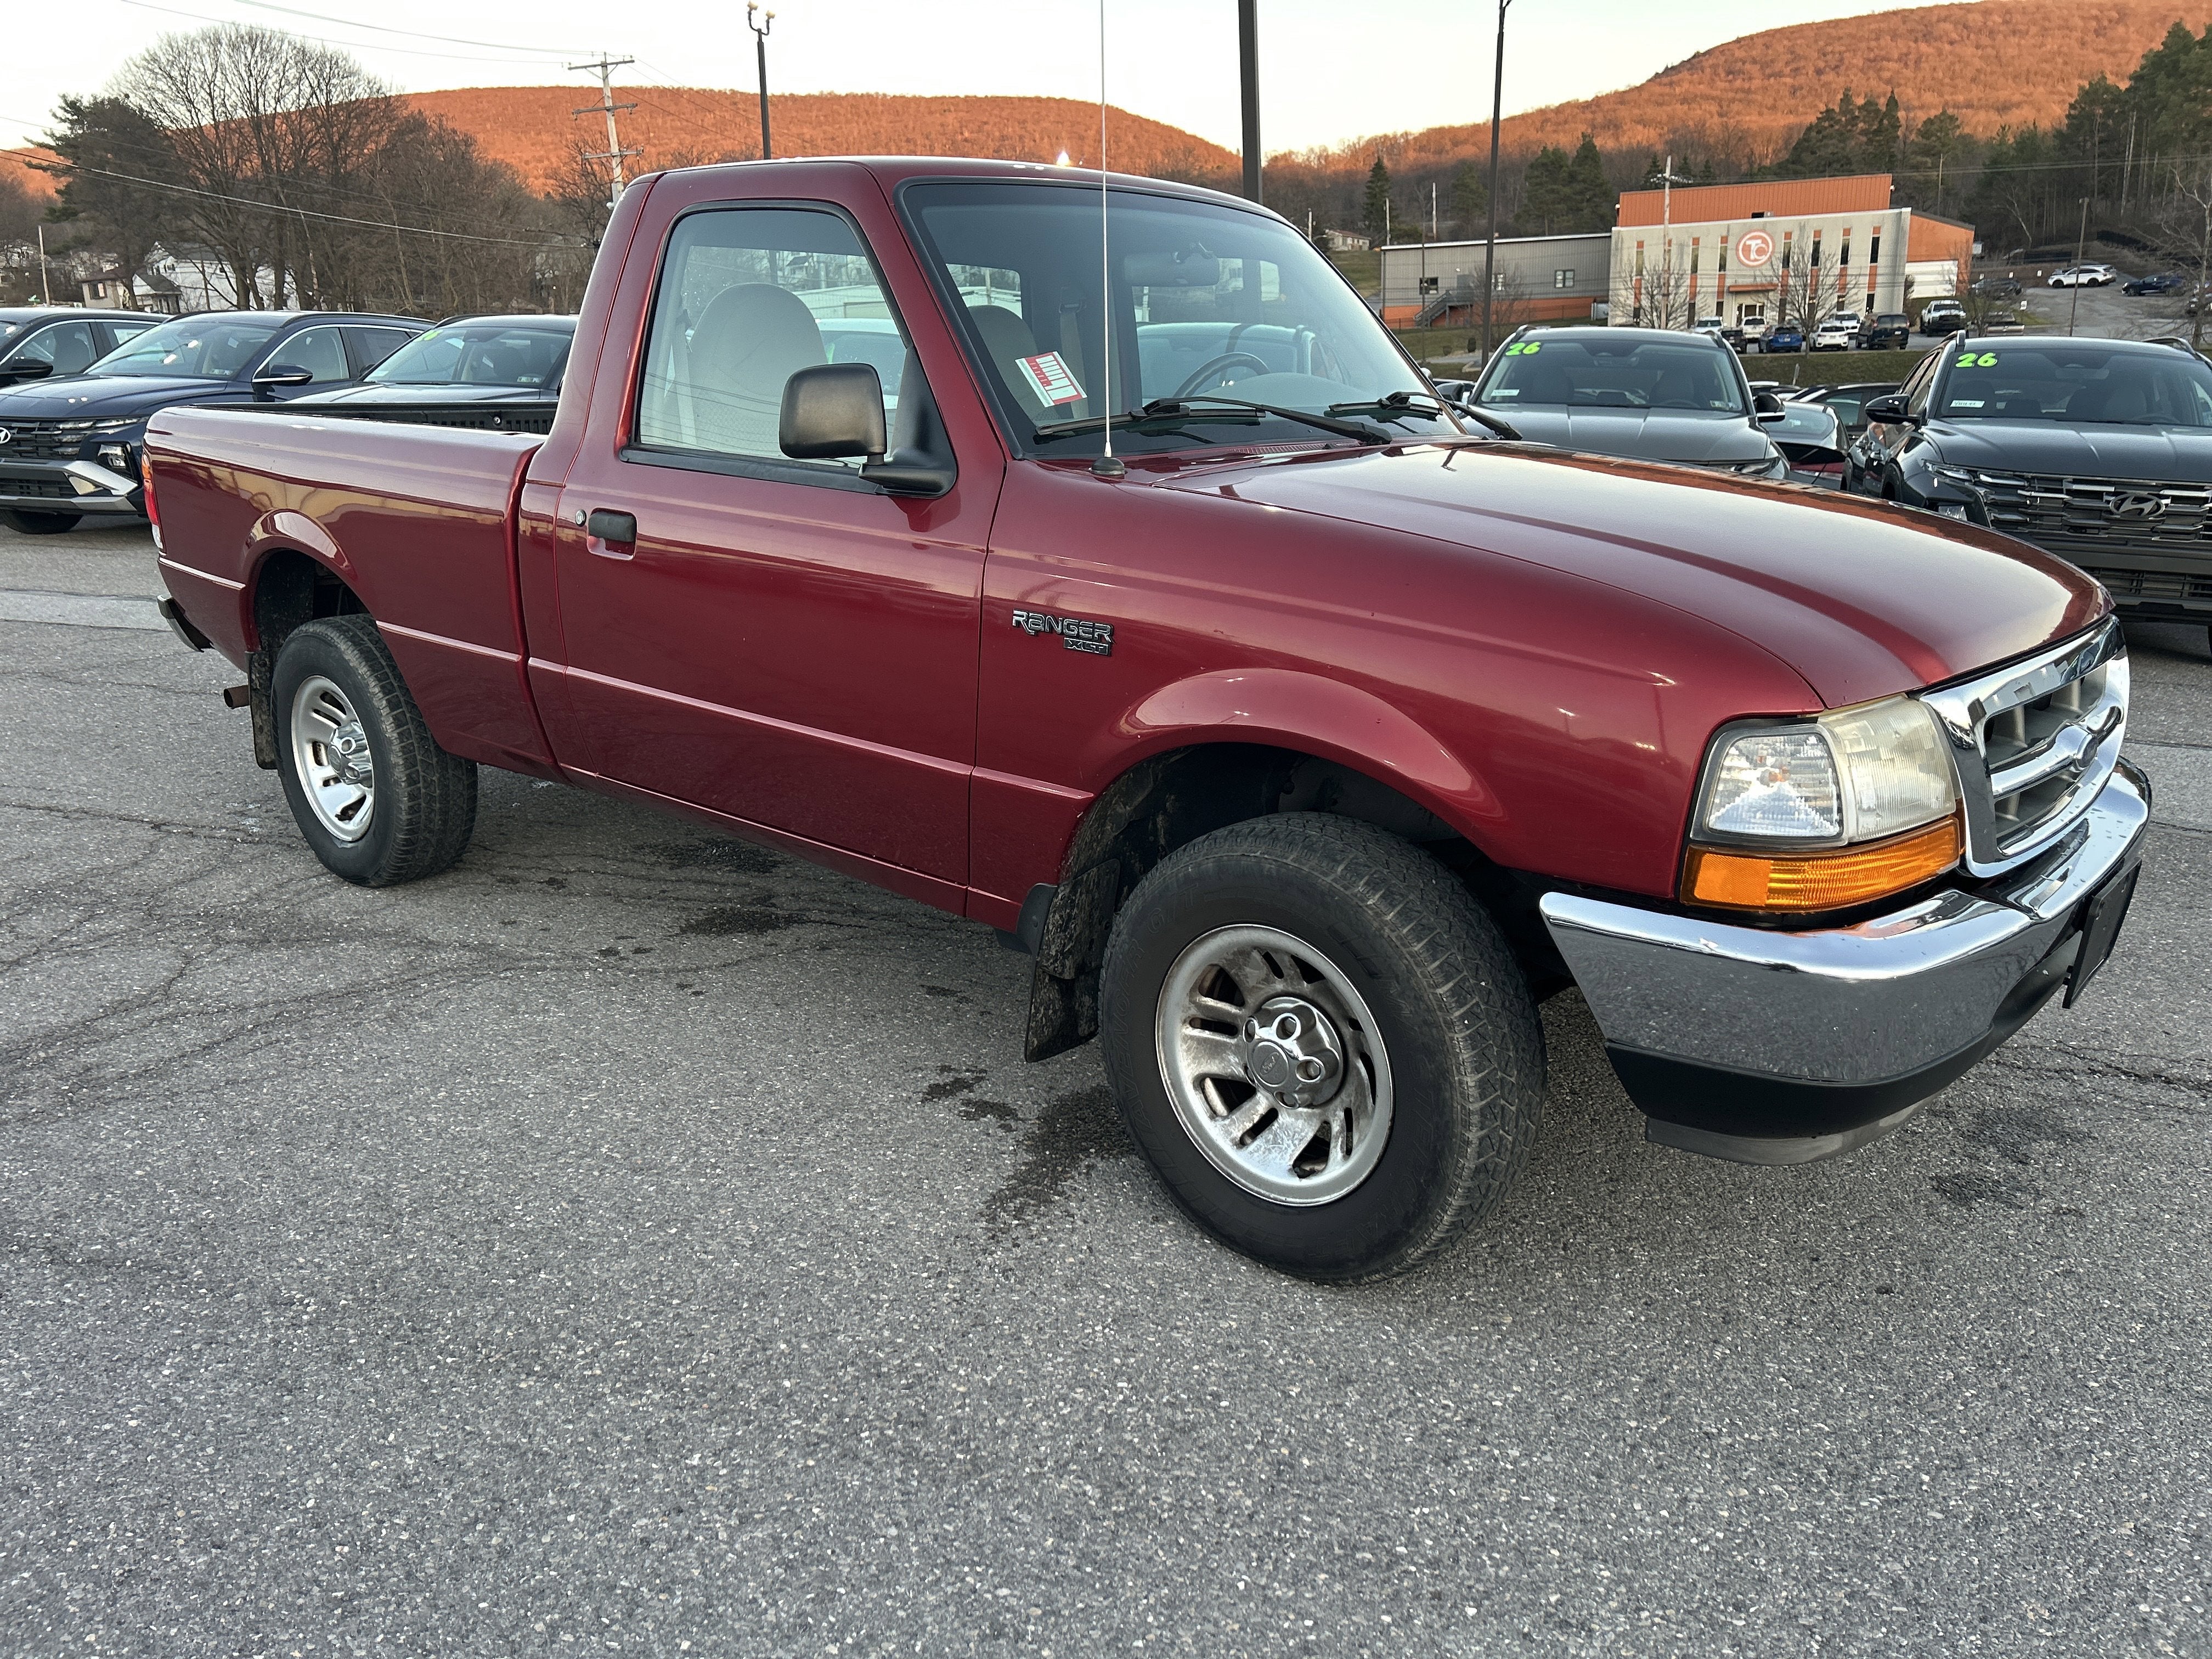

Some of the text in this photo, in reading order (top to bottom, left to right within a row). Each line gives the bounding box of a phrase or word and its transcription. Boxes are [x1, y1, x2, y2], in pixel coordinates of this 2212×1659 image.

[1746, 239, 1768, 260] TC
[1505, 341, 1541, 356] 26
[1955, 352, 1997, 368] 26
[1012, 609, 1113, 643] RANGER
[1067, 639, 1105, 654] XLT
